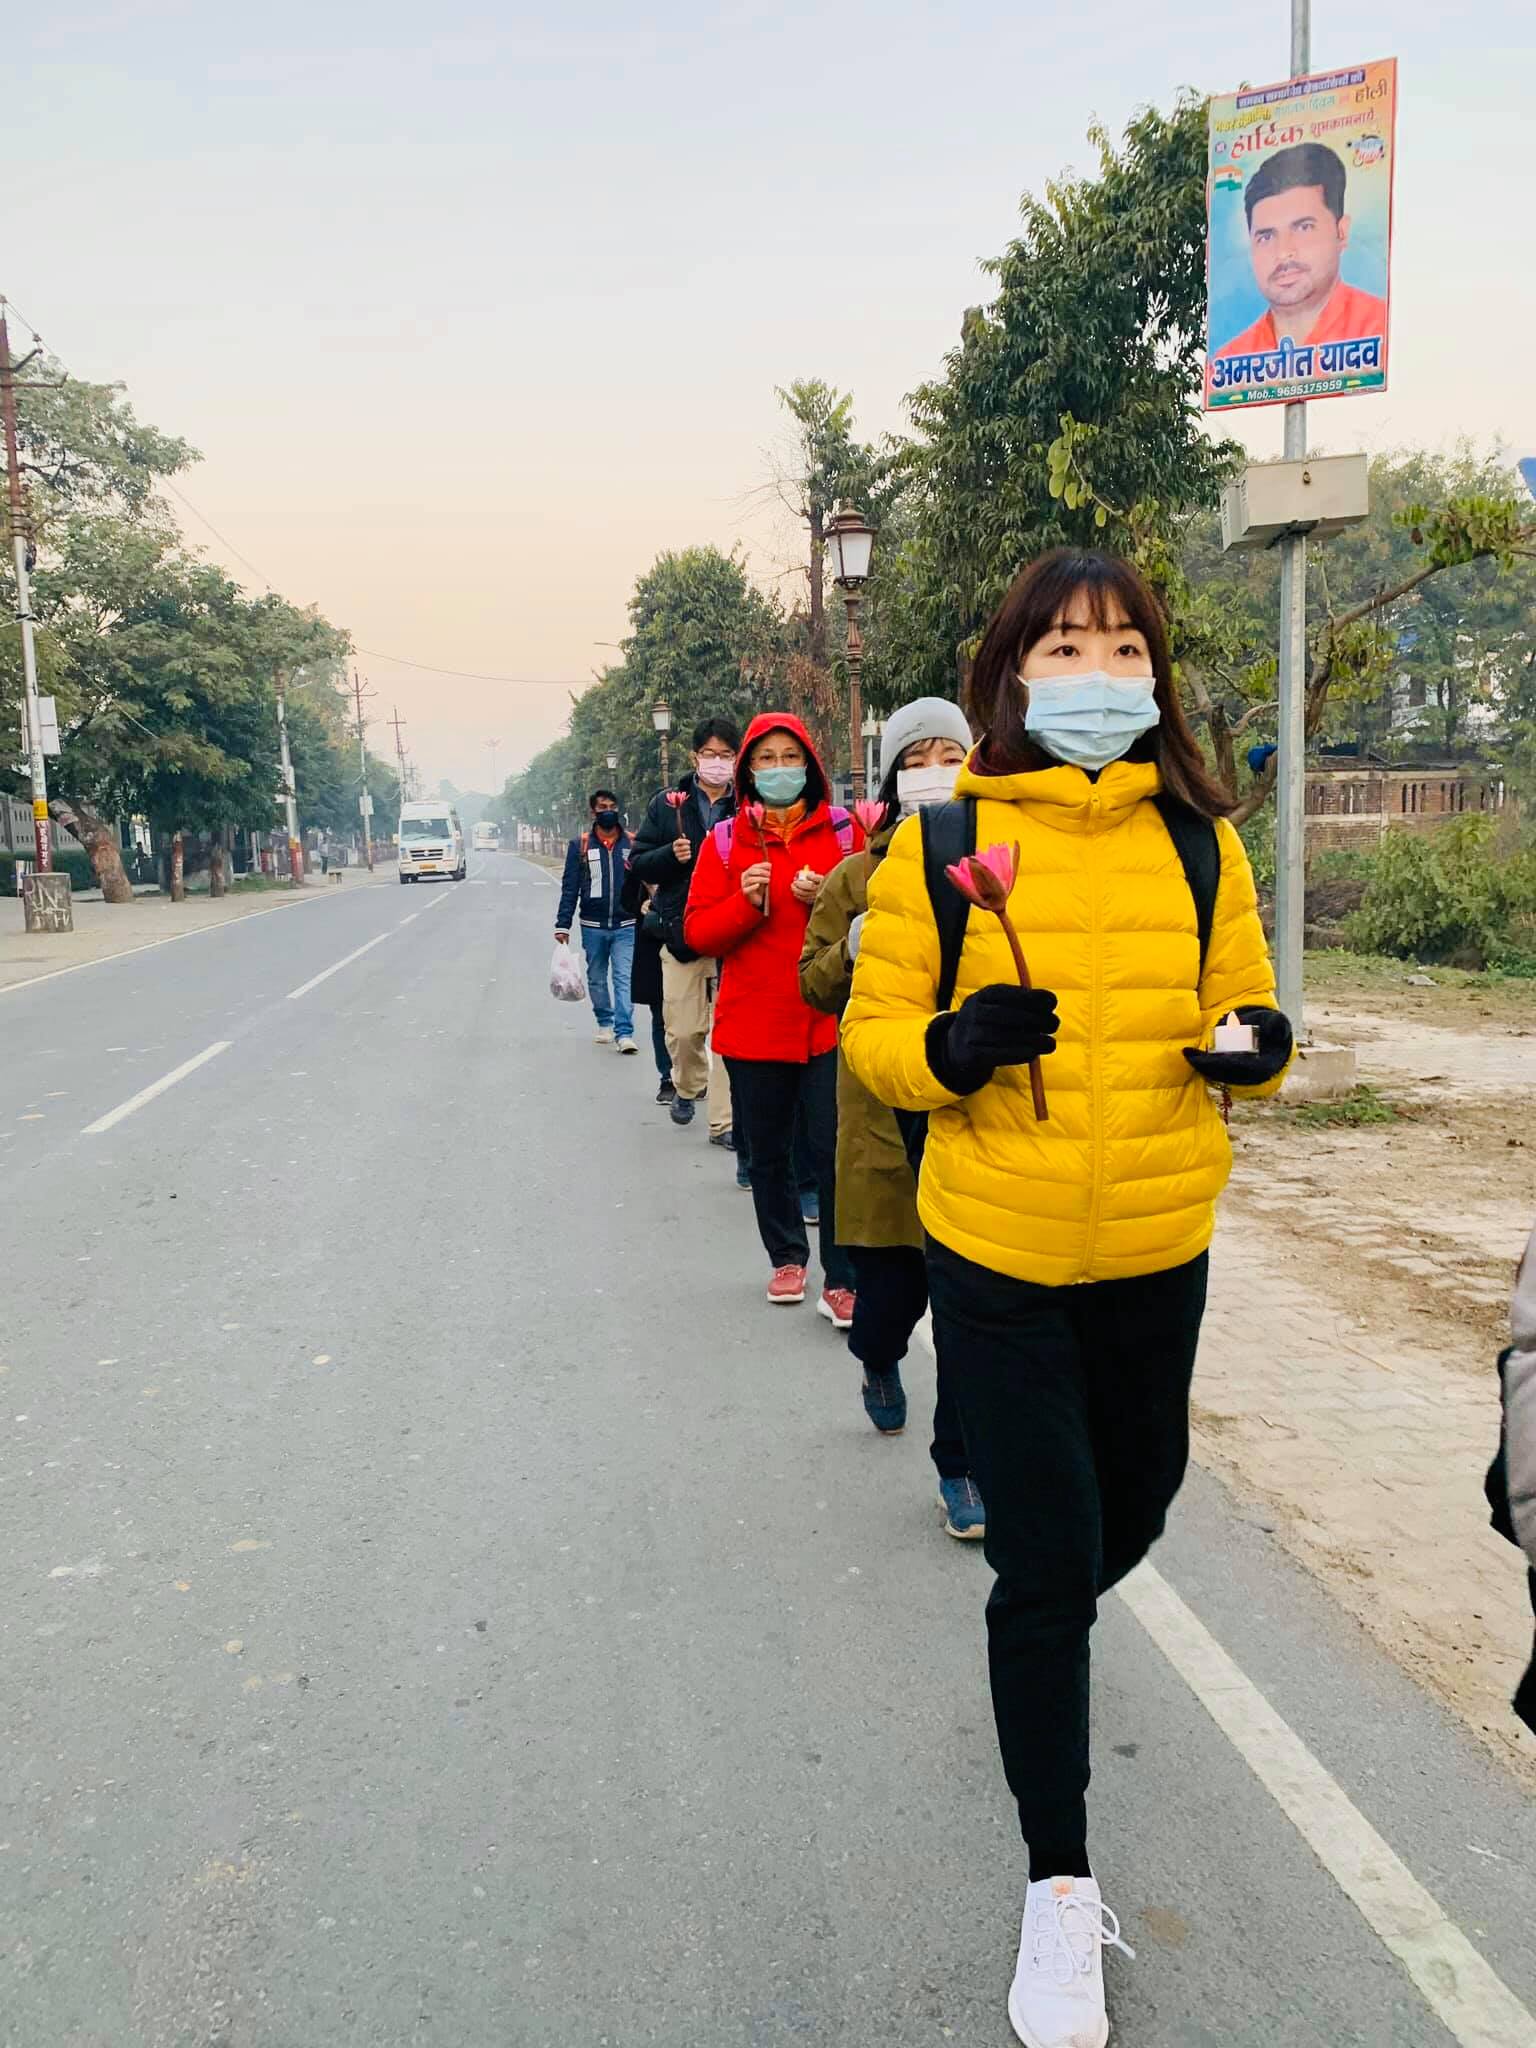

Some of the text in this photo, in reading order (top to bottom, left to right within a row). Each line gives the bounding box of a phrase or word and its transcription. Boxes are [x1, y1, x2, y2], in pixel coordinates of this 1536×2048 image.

[1354, 79, 1388, 103] होली
[1212, 335, 1382, 388] अमरजीत यादव
